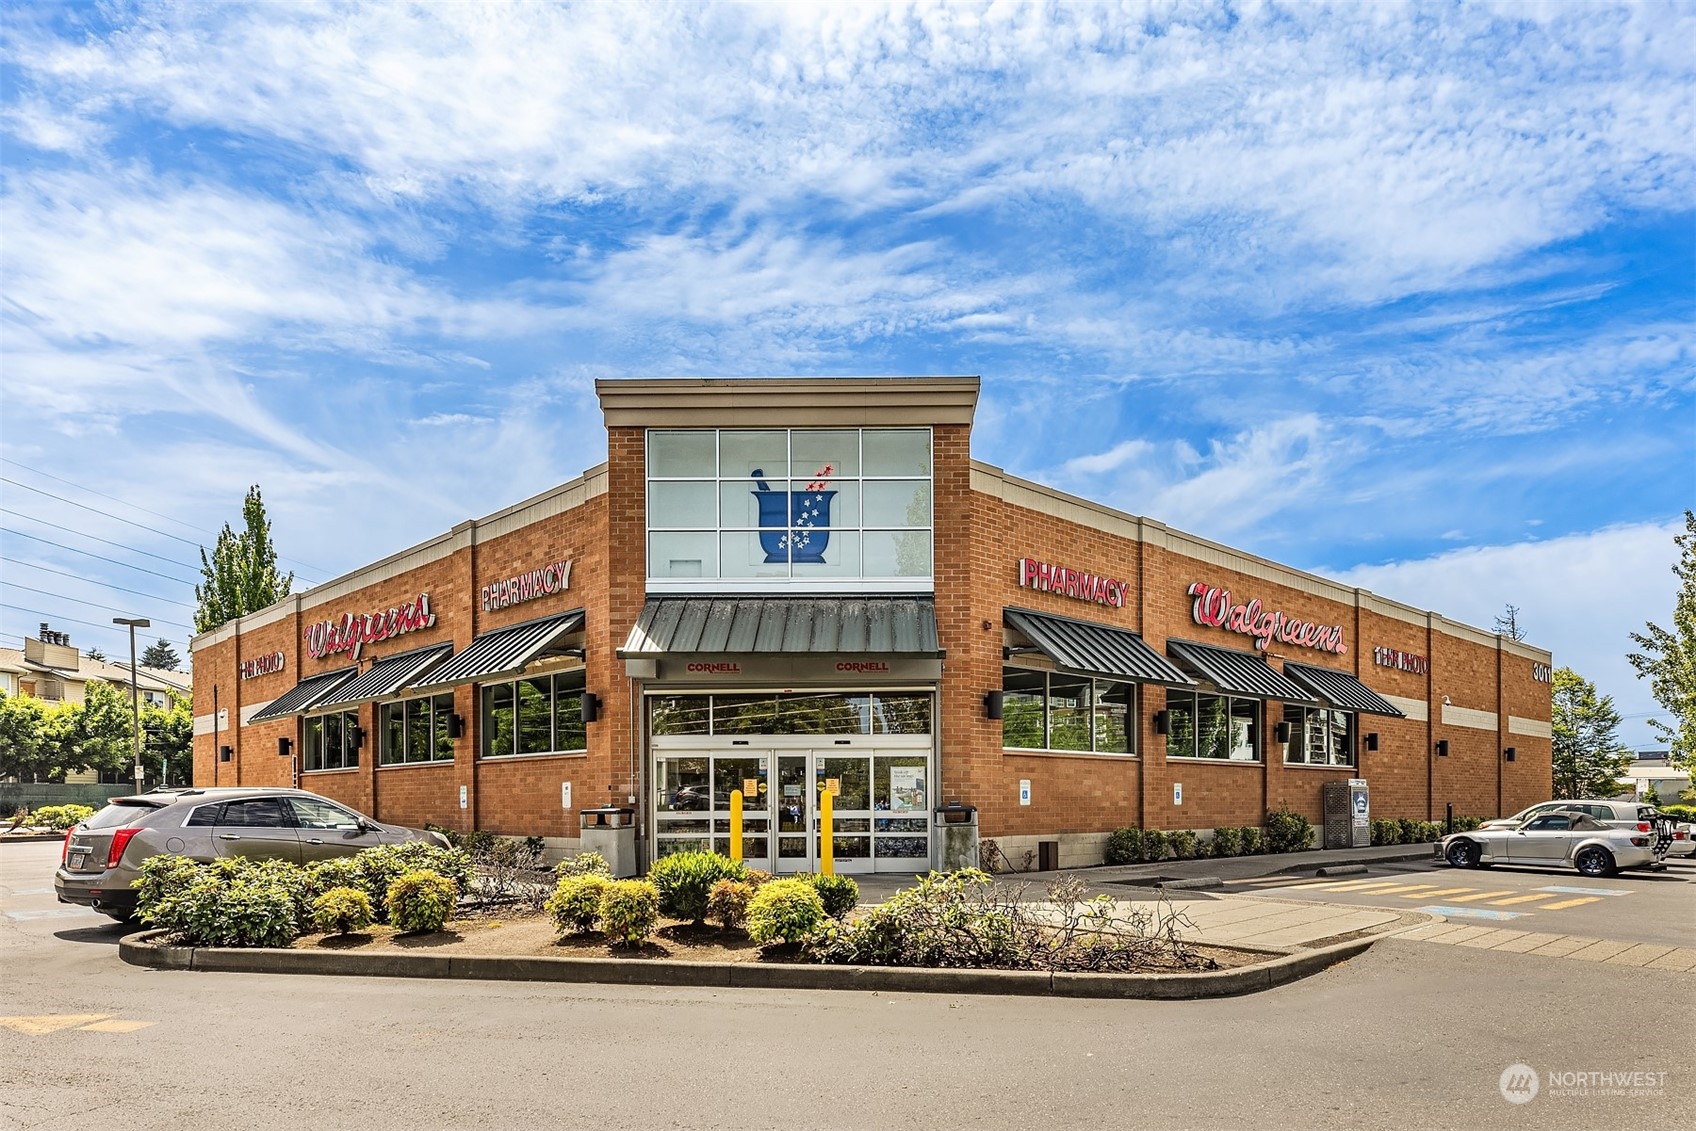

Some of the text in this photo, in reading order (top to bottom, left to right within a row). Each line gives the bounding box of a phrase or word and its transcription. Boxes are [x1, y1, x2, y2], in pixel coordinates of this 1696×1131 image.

[481, 560, 573, 612] PHARMACY
[1019, 558, 1130, 608] PHARMACY
[304, 592, 436, 661] Walgreens
[1188, 582, 1348, 655] Walgreens
[687, 663, 740, 673] CORNELL
[836, 662, 889, 673] CORNELL
[1398, 651, 1430, 675] PHOTO
[1533, 662, 1551, 684] 3011
